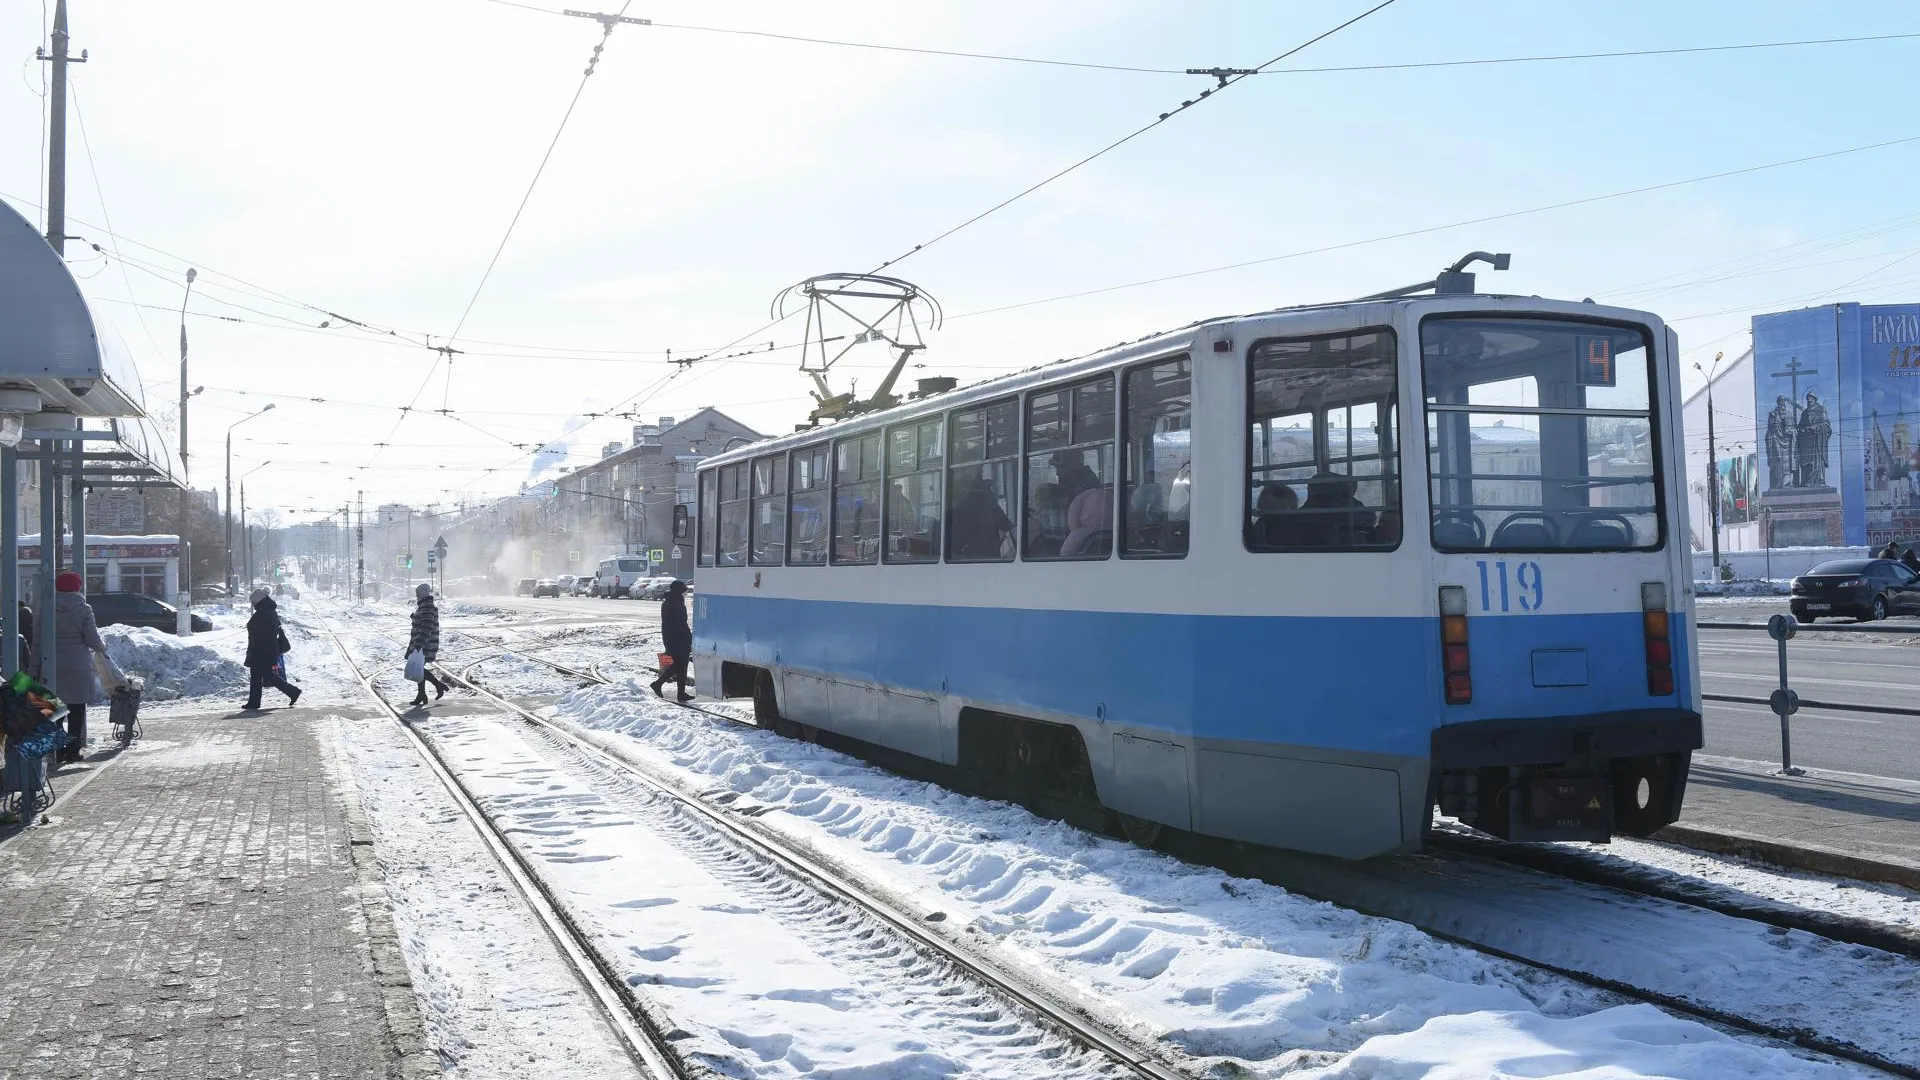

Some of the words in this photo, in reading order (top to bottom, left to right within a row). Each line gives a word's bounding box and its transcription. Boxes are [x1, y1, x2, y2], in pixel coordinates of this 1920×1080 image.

[1872, 315, 1919, 343] КОЛО
[1589, 340, 1609, 382] 4
[1476, 561, 1543, 612] 119
